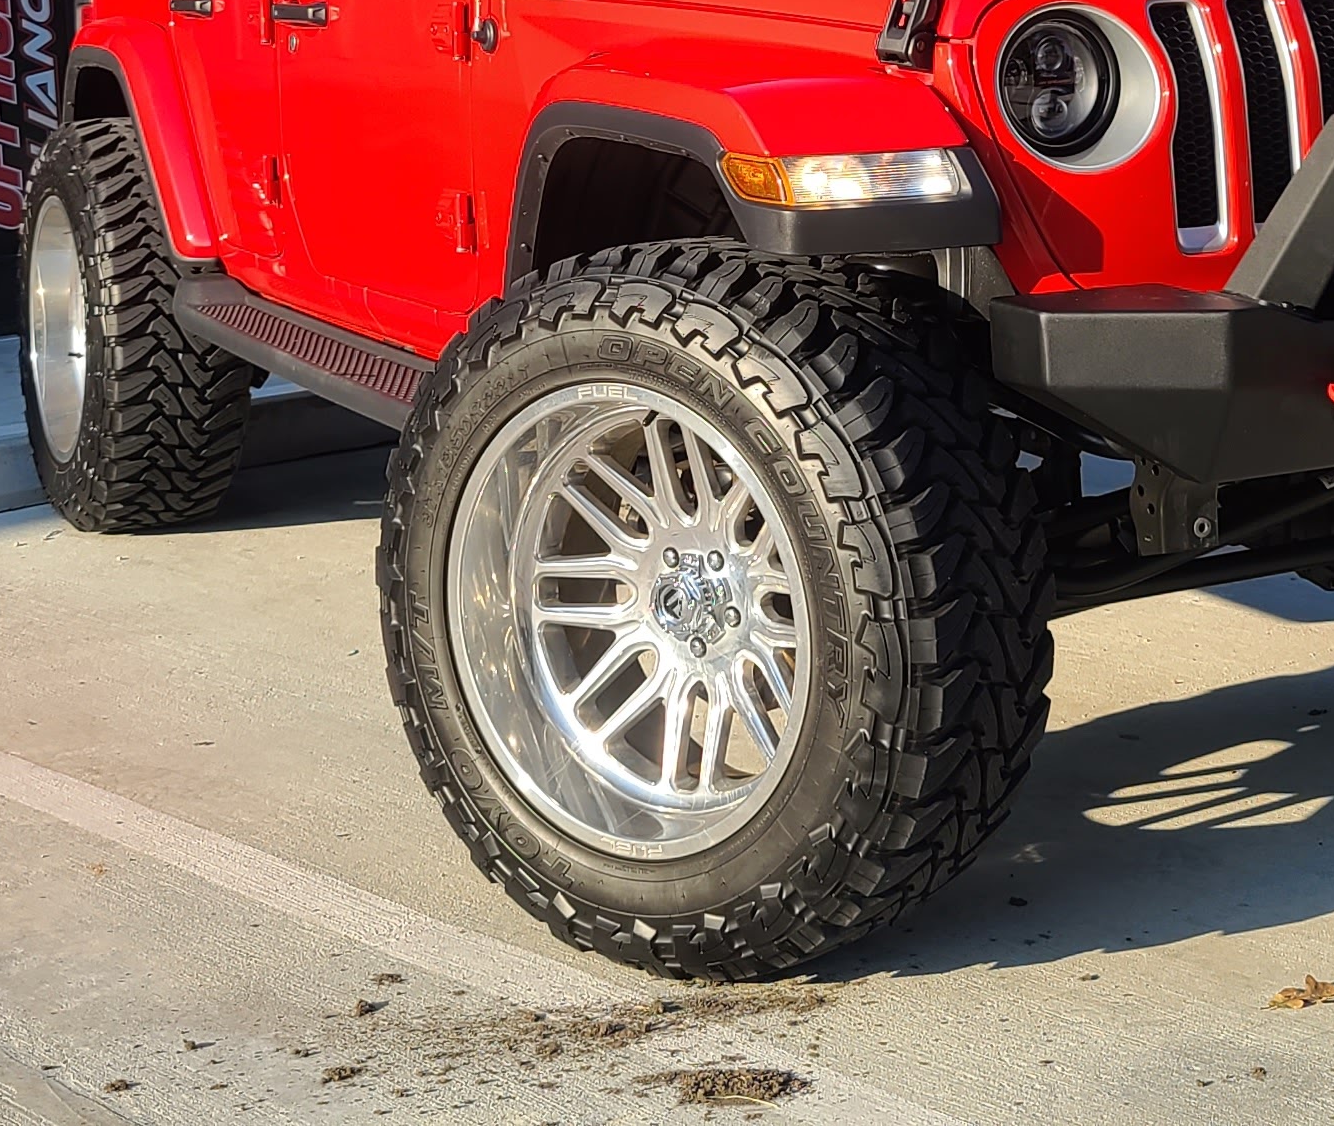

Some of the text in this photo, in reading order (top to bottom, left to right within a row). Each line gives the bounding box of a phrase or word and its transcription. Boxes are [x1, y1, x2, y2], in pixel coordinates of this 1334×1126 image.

[577, 385, 638, 401] FUEL
[597, 334, 737, 410] OPEN
[744, 416, 852, 729] COUNTRY
[408, 589, 575, 889] TOYO M/T
[600, 836, 663, 858] FUEL
